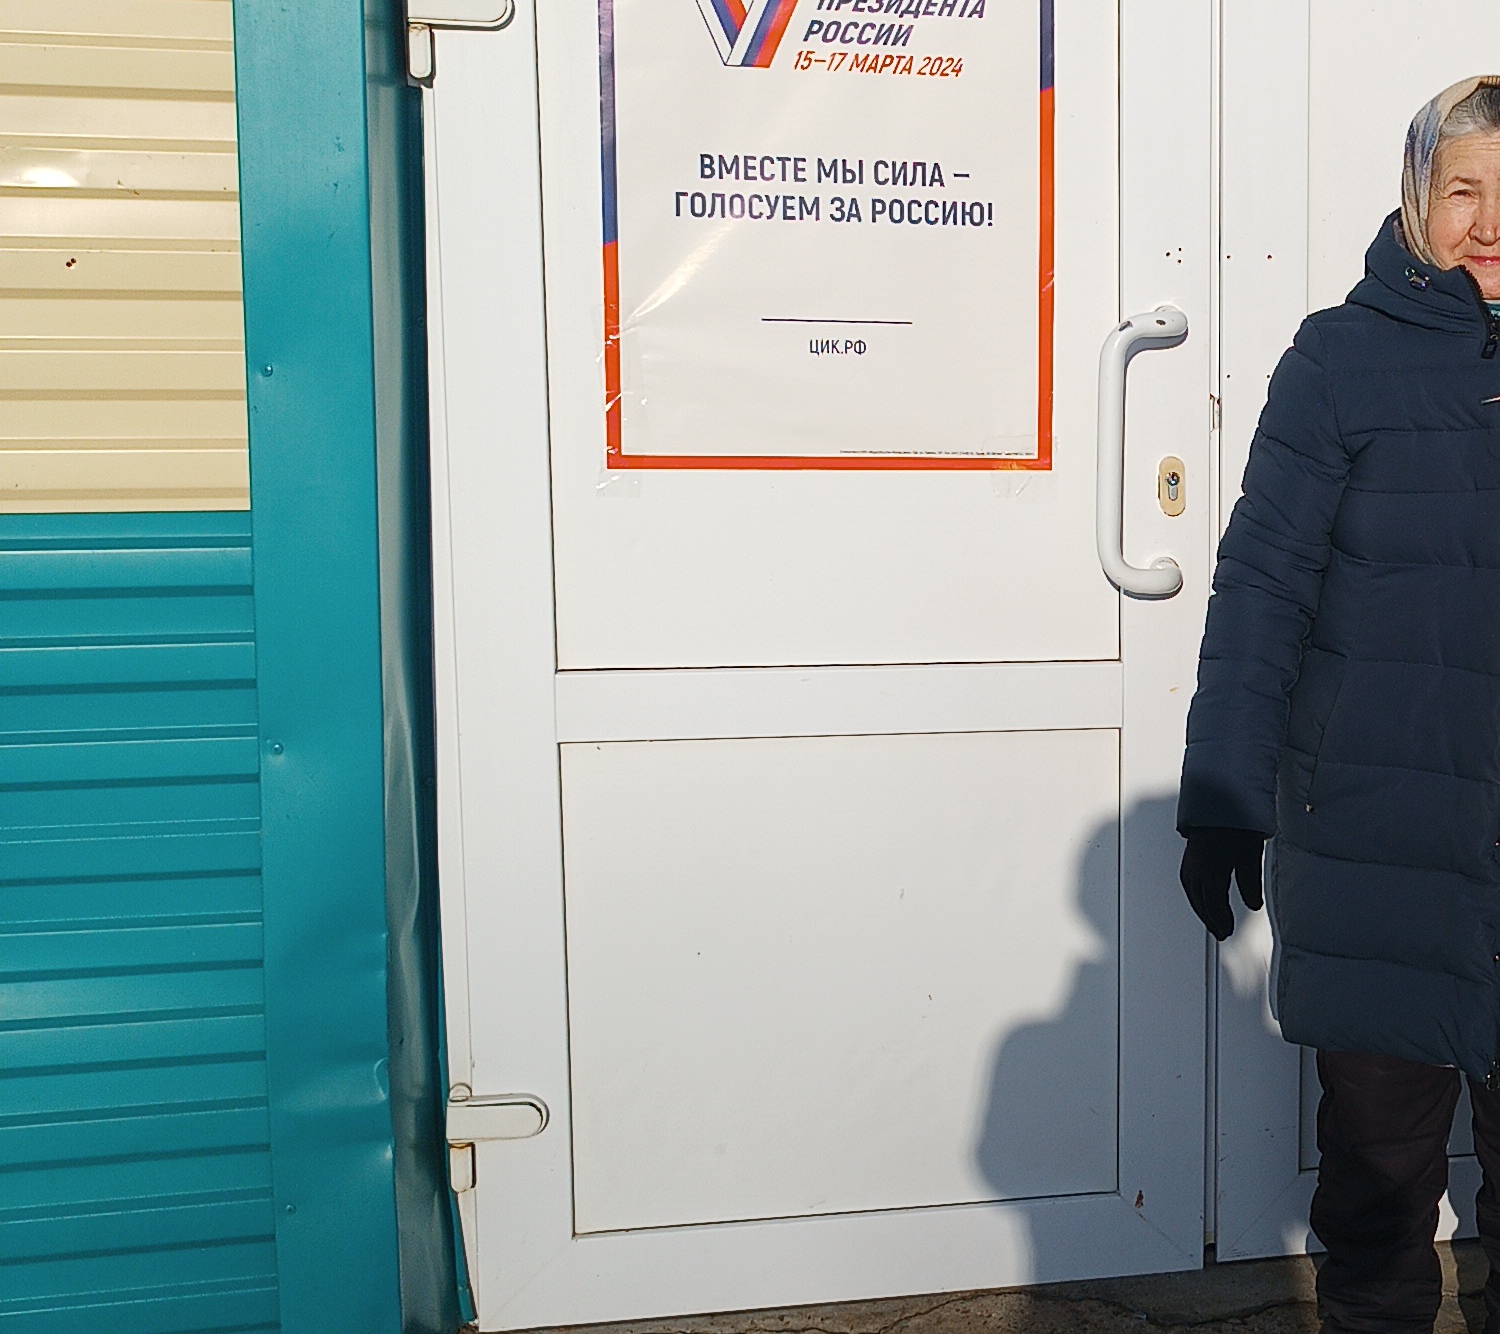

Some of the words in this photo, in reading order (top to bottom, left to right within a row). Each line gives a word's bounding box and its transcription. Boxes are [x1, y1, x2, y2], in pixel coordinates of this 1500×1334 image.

[802, 19, 915, 47] РОССИИ
[848, 52, 914, 76] МАРТА
[916, 55, 964, 78] 2024
[699, 153, 808, 183] ВМЕСТЕ
[817, 157, 865, 185] МЫ
[873, 159, 946, 188] СИЛА
[674, 191, 821, 222] ГОЛОСУЕМ
[829, 196, 862, 223] ЗА
[871, 198, 994, 227] РОССИЮ!
[809, 338, 867, 357] ЦИК.РФ
